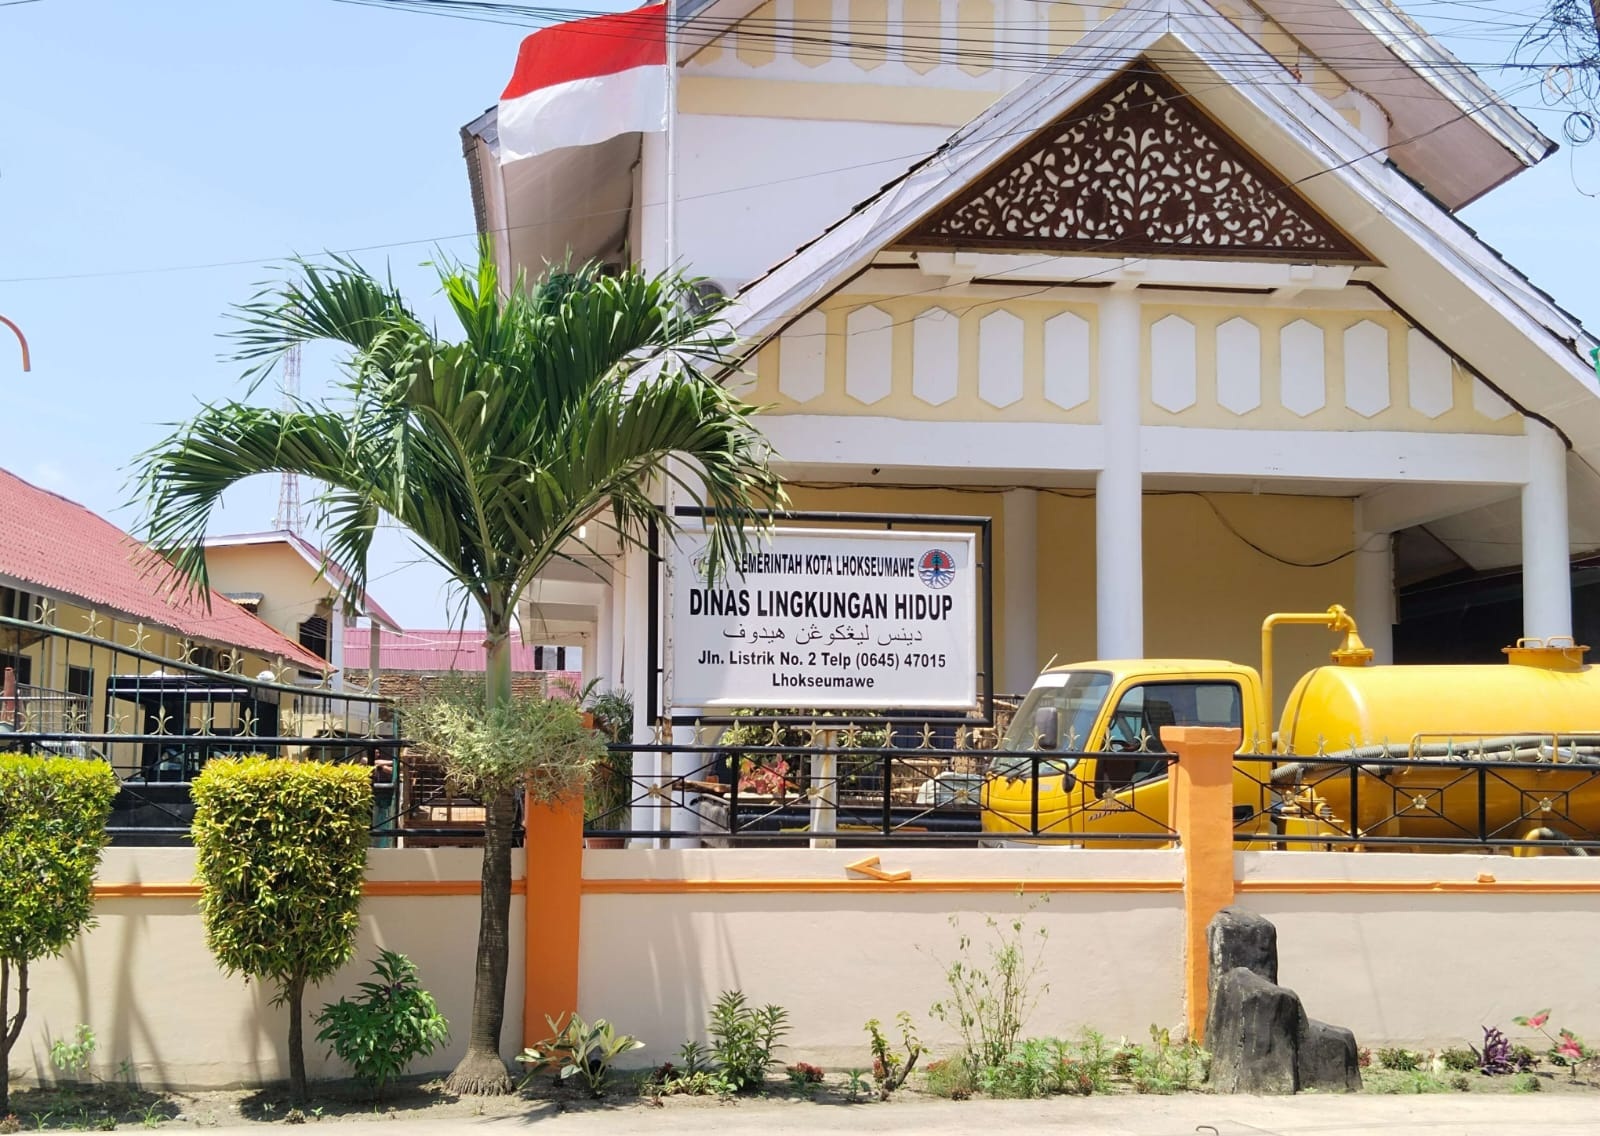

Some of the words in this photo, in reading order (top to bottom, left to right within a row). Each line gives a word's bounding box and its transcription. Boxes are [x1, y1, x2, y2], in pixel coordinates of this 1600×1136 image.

[805, 554, 833, 575] KOTA
[836, 555, 915, 577] LHOKSEUMAWE
[690, 588, 750, 616] DINAS
[757, 590, 887, 619] LINGKUNGAN
[895, 593, 953, 620] HIDUP
[698, 650, 725, 665] Jln.
[729, 650, 775, 665] Listrik
[780, 651, 803, 666] No.
[808, 652, 817, 666] 2
[821, 652, 851, 670] Telp
[856, 652, 900, 671] (0645)
[904, 653, 946, 668] 47015
[772, 672, 875, 688] Lhokseumawe
